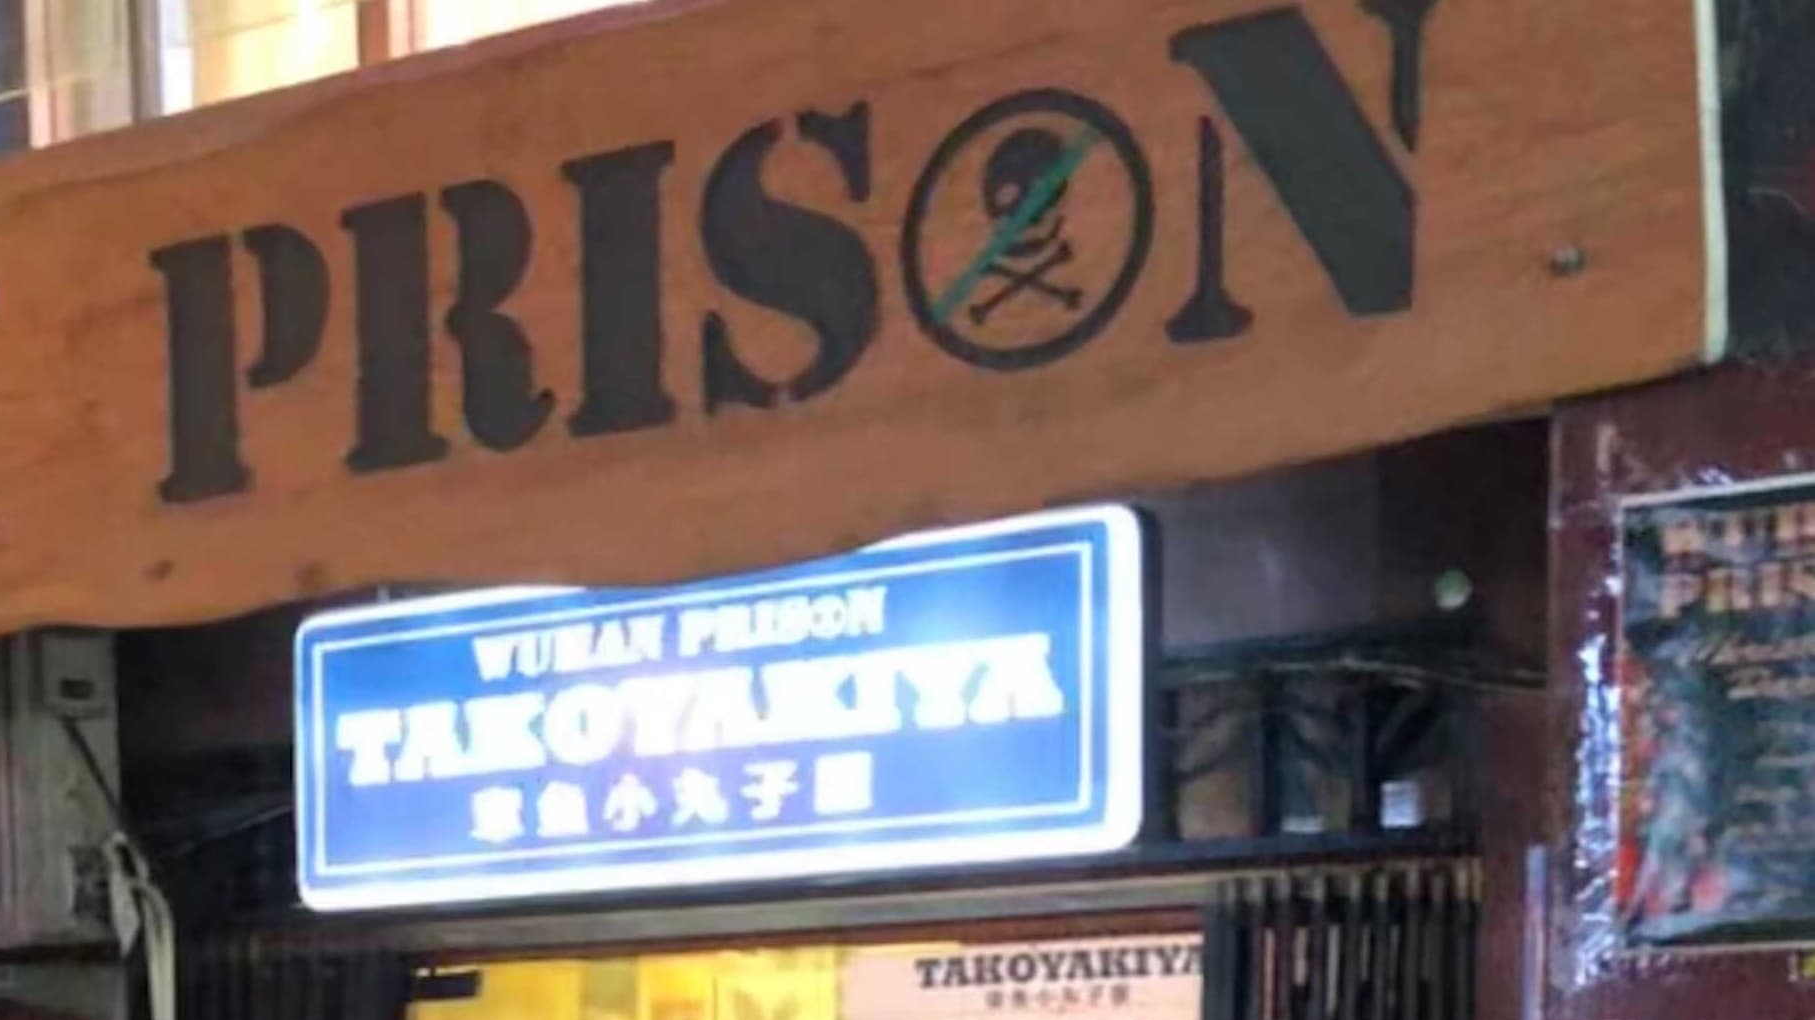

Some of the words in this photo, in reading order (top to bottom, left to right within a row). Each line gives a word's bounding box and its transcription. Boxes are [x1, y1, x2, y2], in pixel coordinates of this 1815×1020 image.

[149, 0, 1435, 504] PRISON
[473, 614, 666, 682] WUHAN
[679, 585, 887, 657] PRISON
[336, 632, 1064, 786] TAKOYAKIYA
[915, 944, 1201, 989] TAKOYAKIYA
